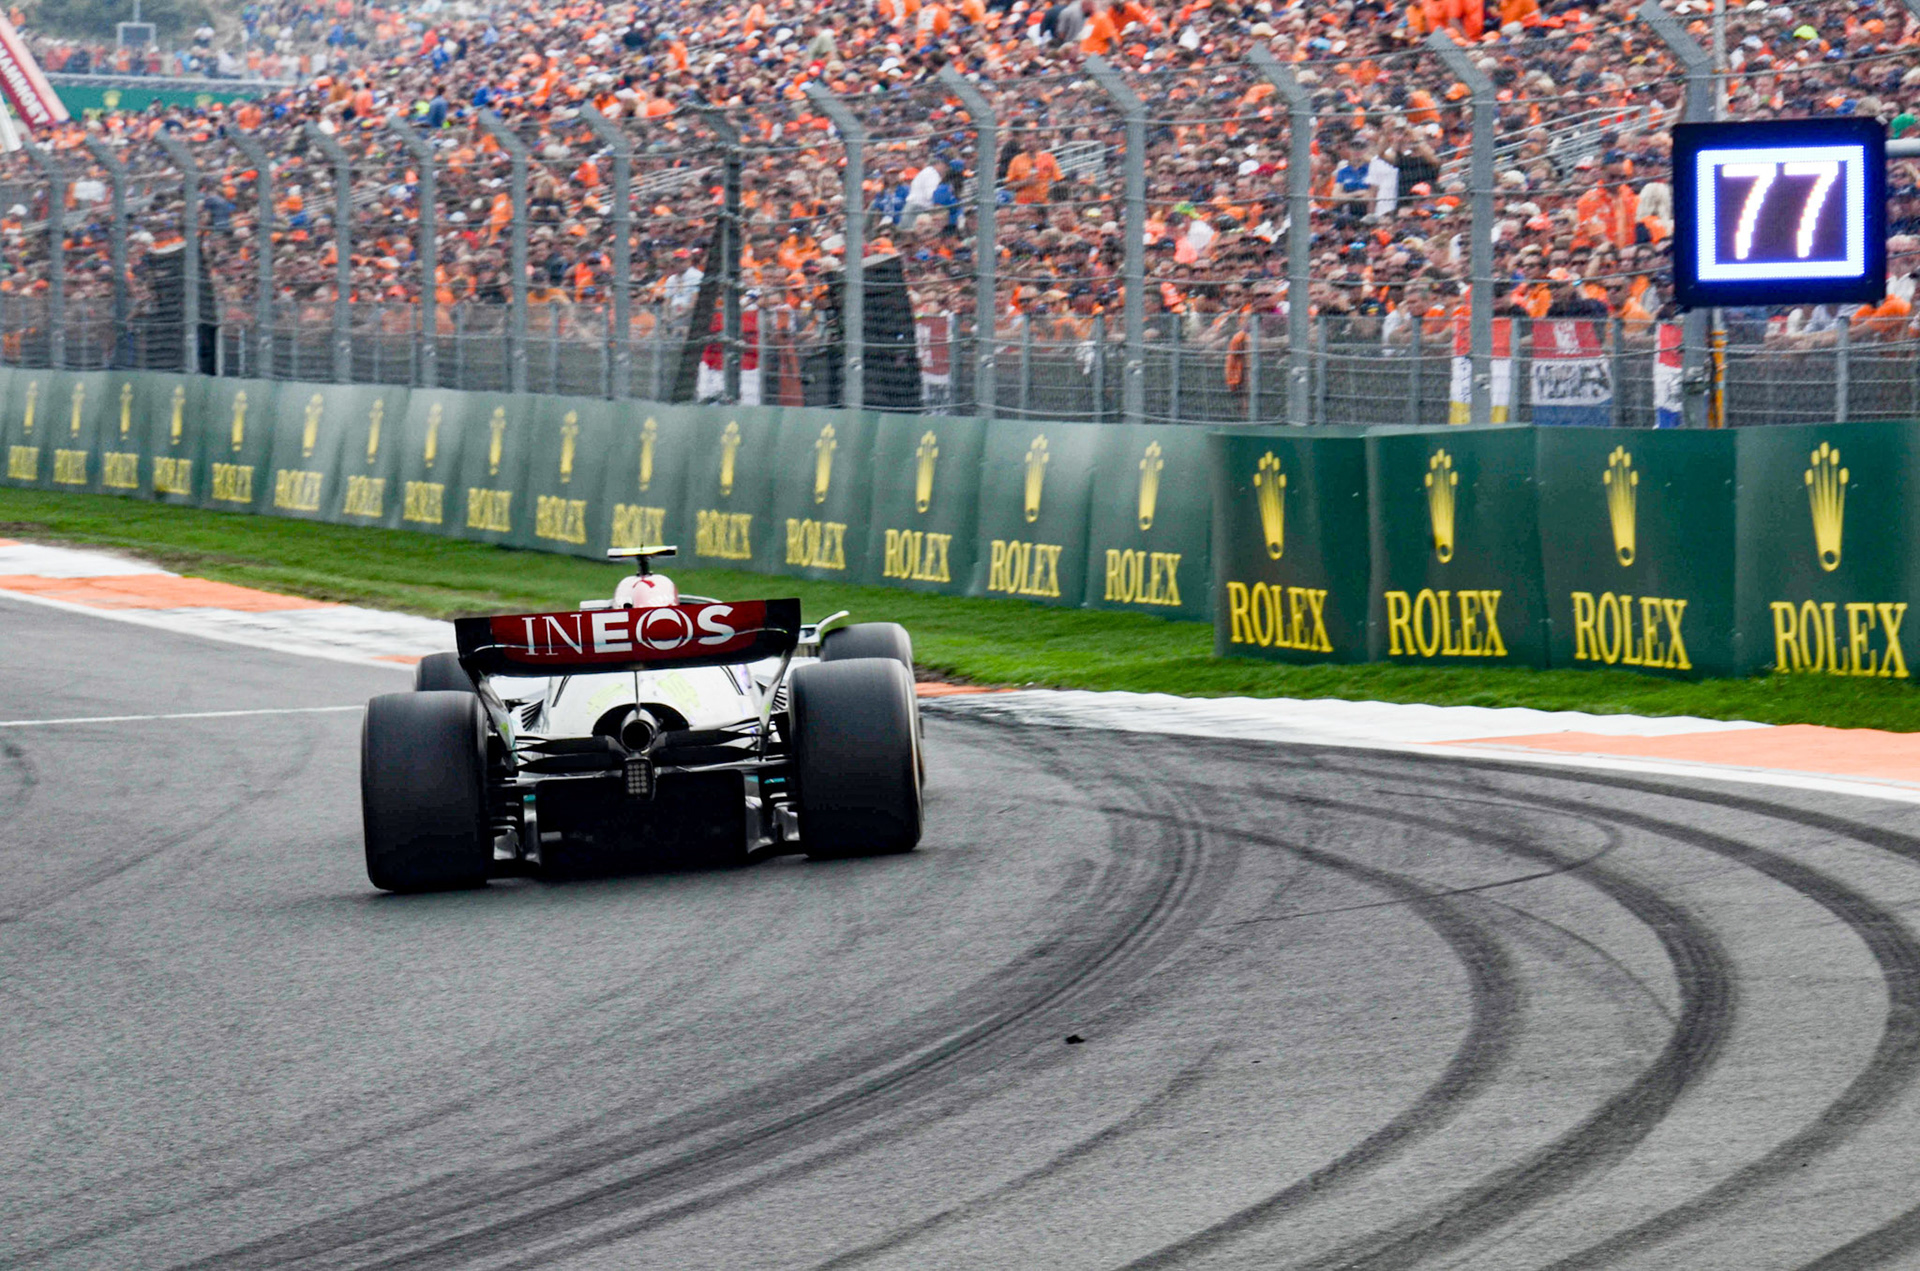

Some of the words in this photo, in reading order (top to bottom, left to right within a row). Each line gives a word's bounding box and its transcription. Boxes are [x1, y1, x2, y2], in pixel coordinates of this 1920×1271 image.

[1722, 161, 1839, 260] 77
[786, 518, 847, 570] ROLEX
[883, 529, 952, 582] ROLEX
[987, 540, 1063, 597] ROLEX
[1105, 548, 1182, 606] ROLEX
[521, 604, 736, 656] INEOS
[1226, 581, 1334, 653] ROLEX
[1384, 588, 1508, 657] ROLEX
[1571, 591, 1692, 670] ROLEX
[1770, 600, 1910, 678] ROLEX
